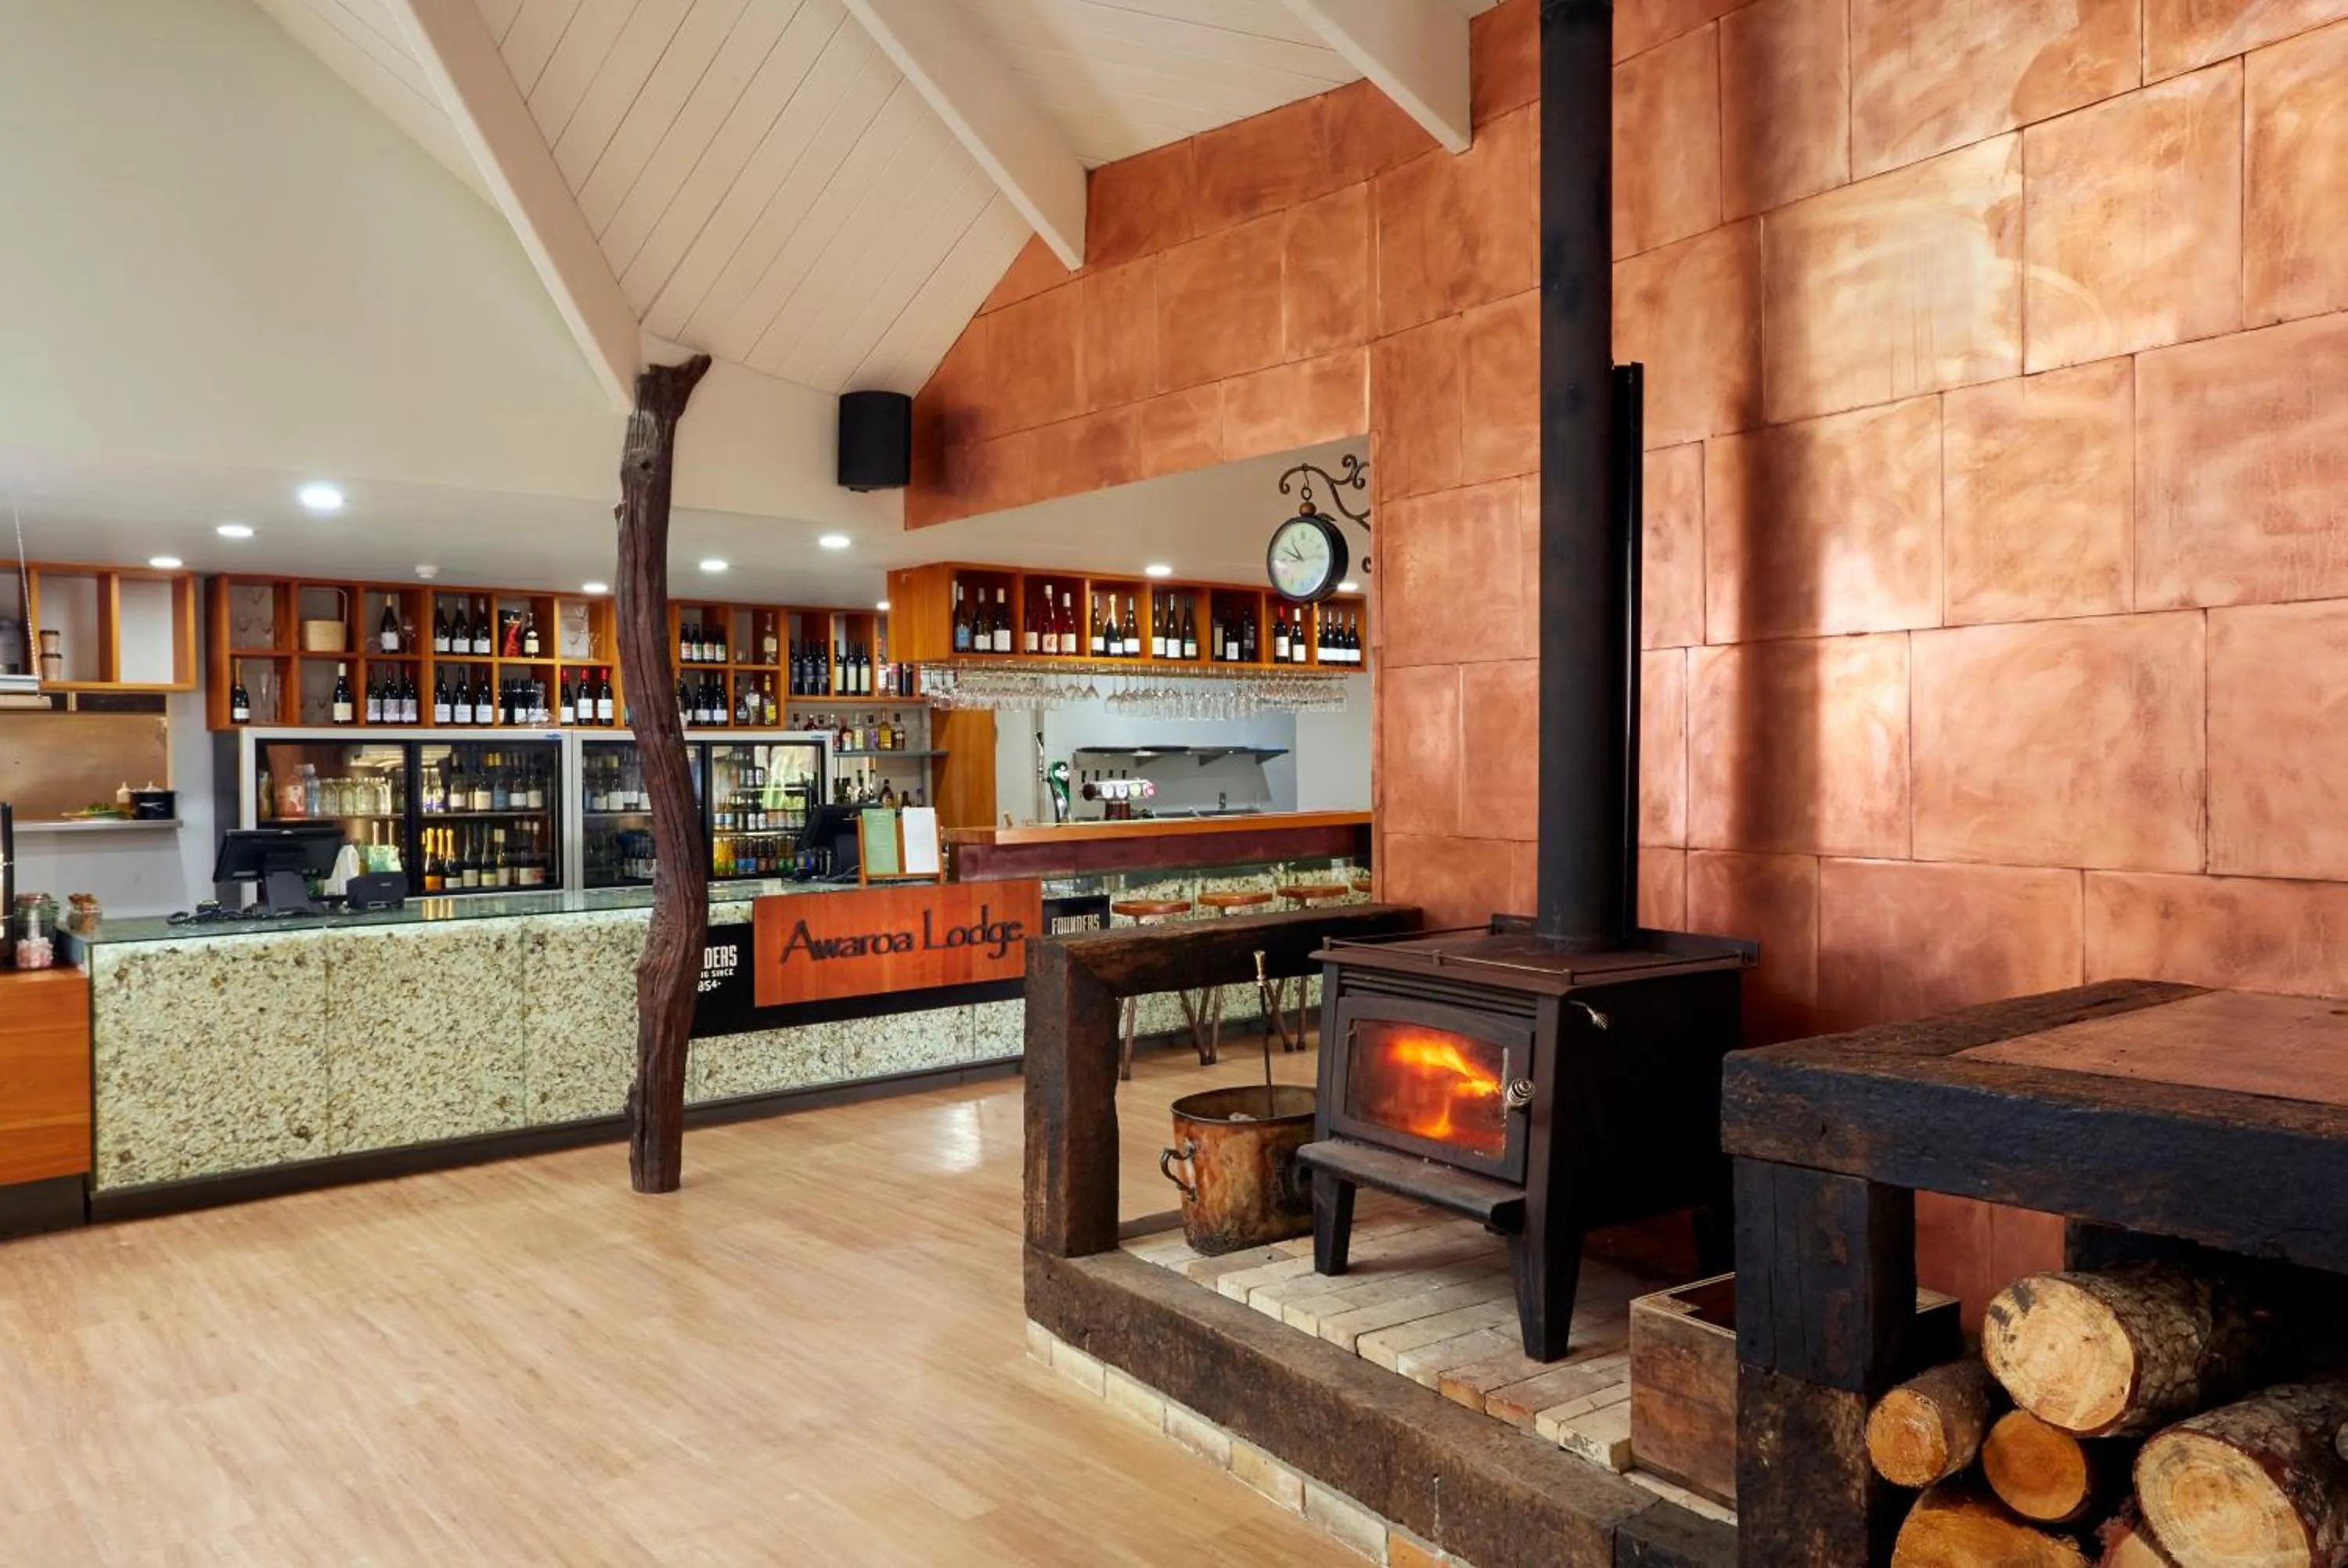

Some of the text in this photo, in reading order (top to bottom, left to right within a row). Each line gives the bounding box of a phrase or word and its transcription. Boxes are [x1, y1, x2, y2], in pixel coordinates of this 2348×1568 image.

[779, 904, 1024, 965] Awaroa Lodge
[1051, 913, 1100, 935] FOUNDERS
[704, 944, 738, 969] DERS
